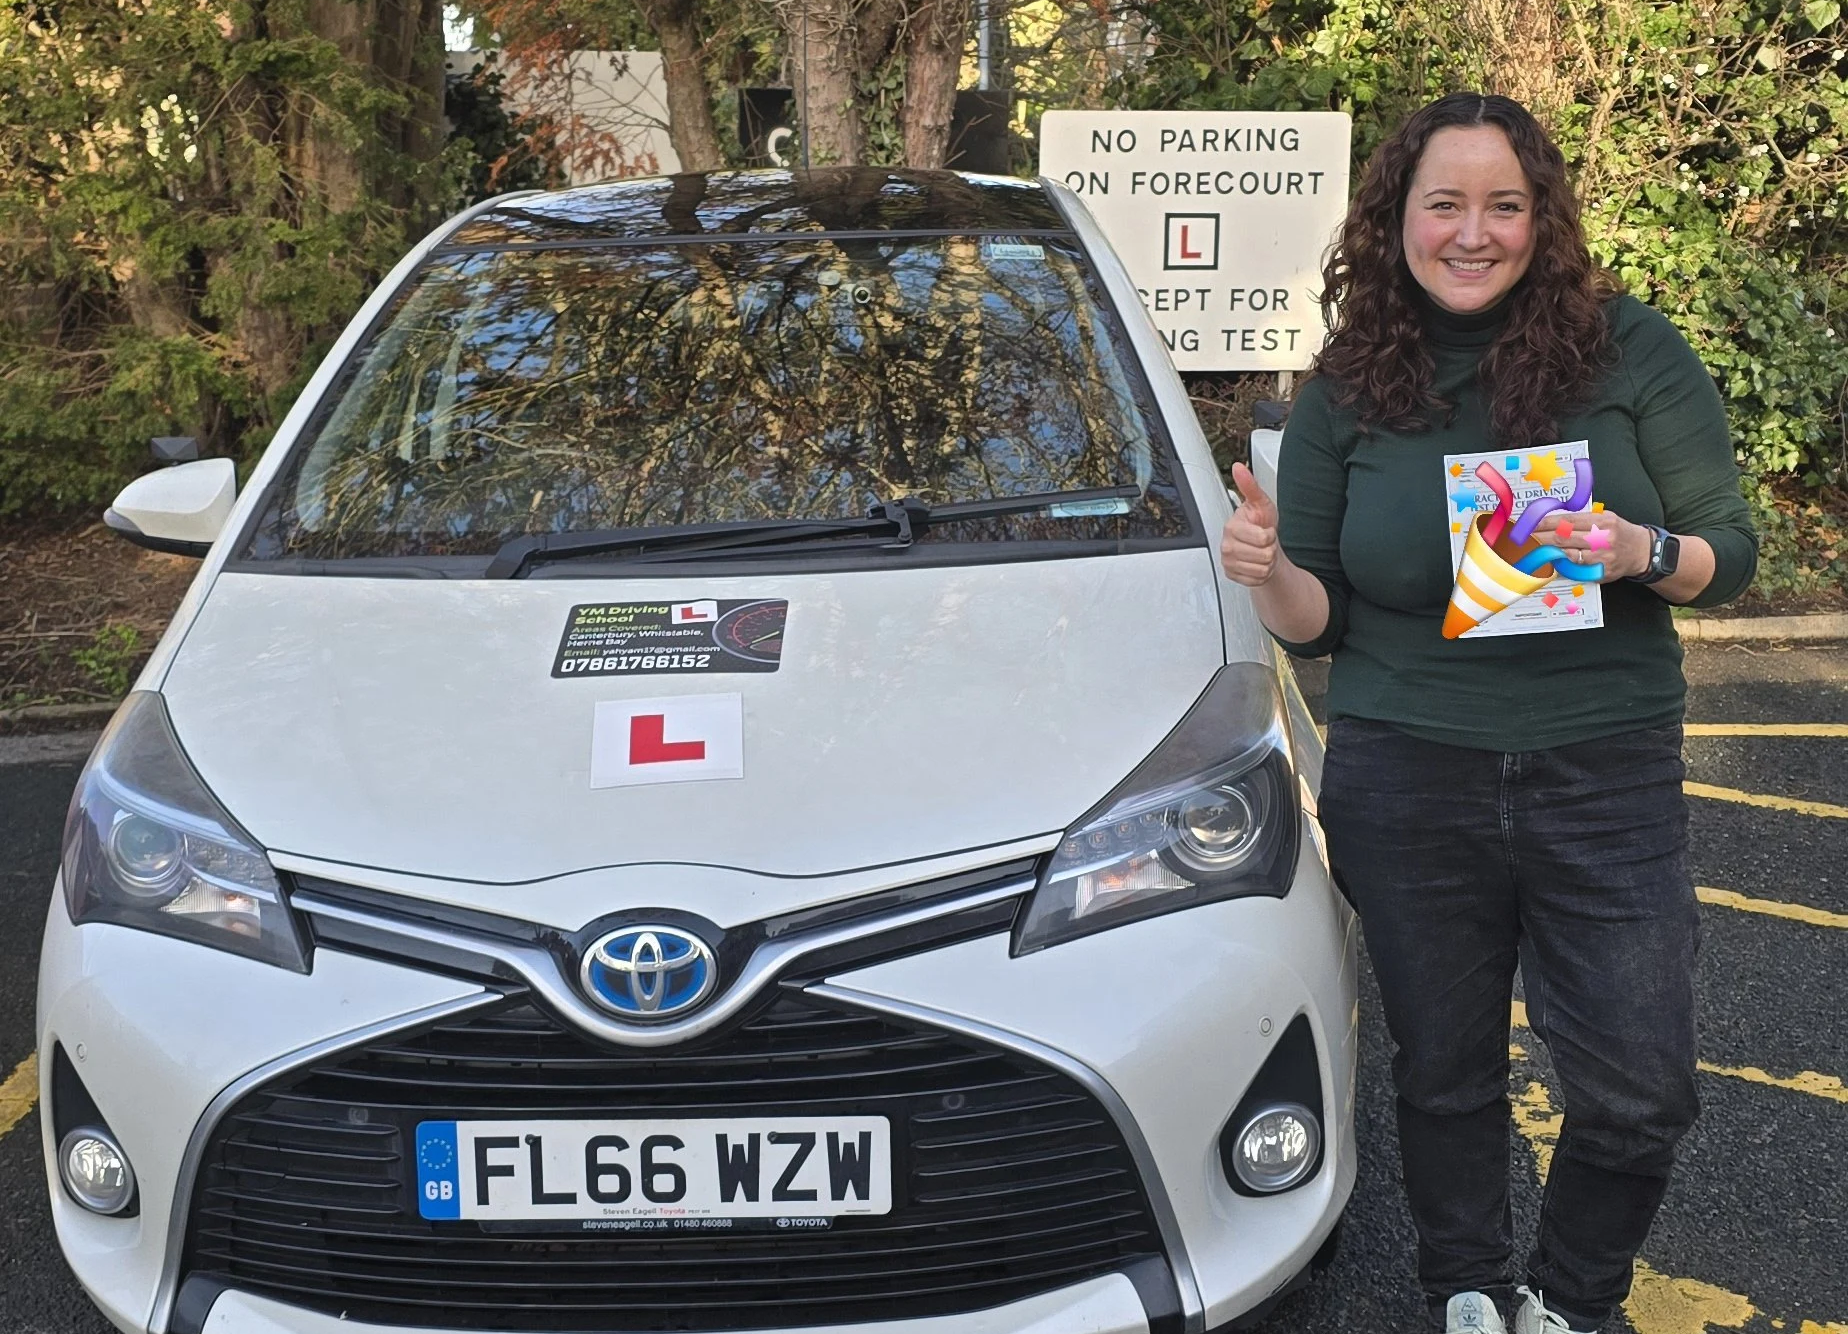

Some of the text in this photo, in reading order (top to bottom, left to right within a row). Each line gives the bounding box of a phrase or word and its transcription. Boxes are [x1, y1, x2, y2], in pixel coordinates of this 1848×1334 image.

[1091, 128, 1300, 153] NO PARKING
[1065, 170, 1325, 196] ON FORECOURT
[1180, 224, 1202, 259] L
[1229, 288, 1290, 312] FOR
[1221, 328, 1302, 352] TEST
[1525, 486, 1570, 499] DRIVING
[574, 615, 634, 625] School
[578, 605, 669, 616] YM Driving
[681, 607, 708, 620] L
[605, 638, 629, 647] Bay
[560, 654, 711, 673] 07861766152
[629, 714, 705, 765] L
[425, 1131, 872, 1207] GB FL66 WZW
[632, 1207, 657, 1216] Eagell
[659, 1207, 686, 1216] Toyota
[791, 1218, 828, 1227] TOYOTA
